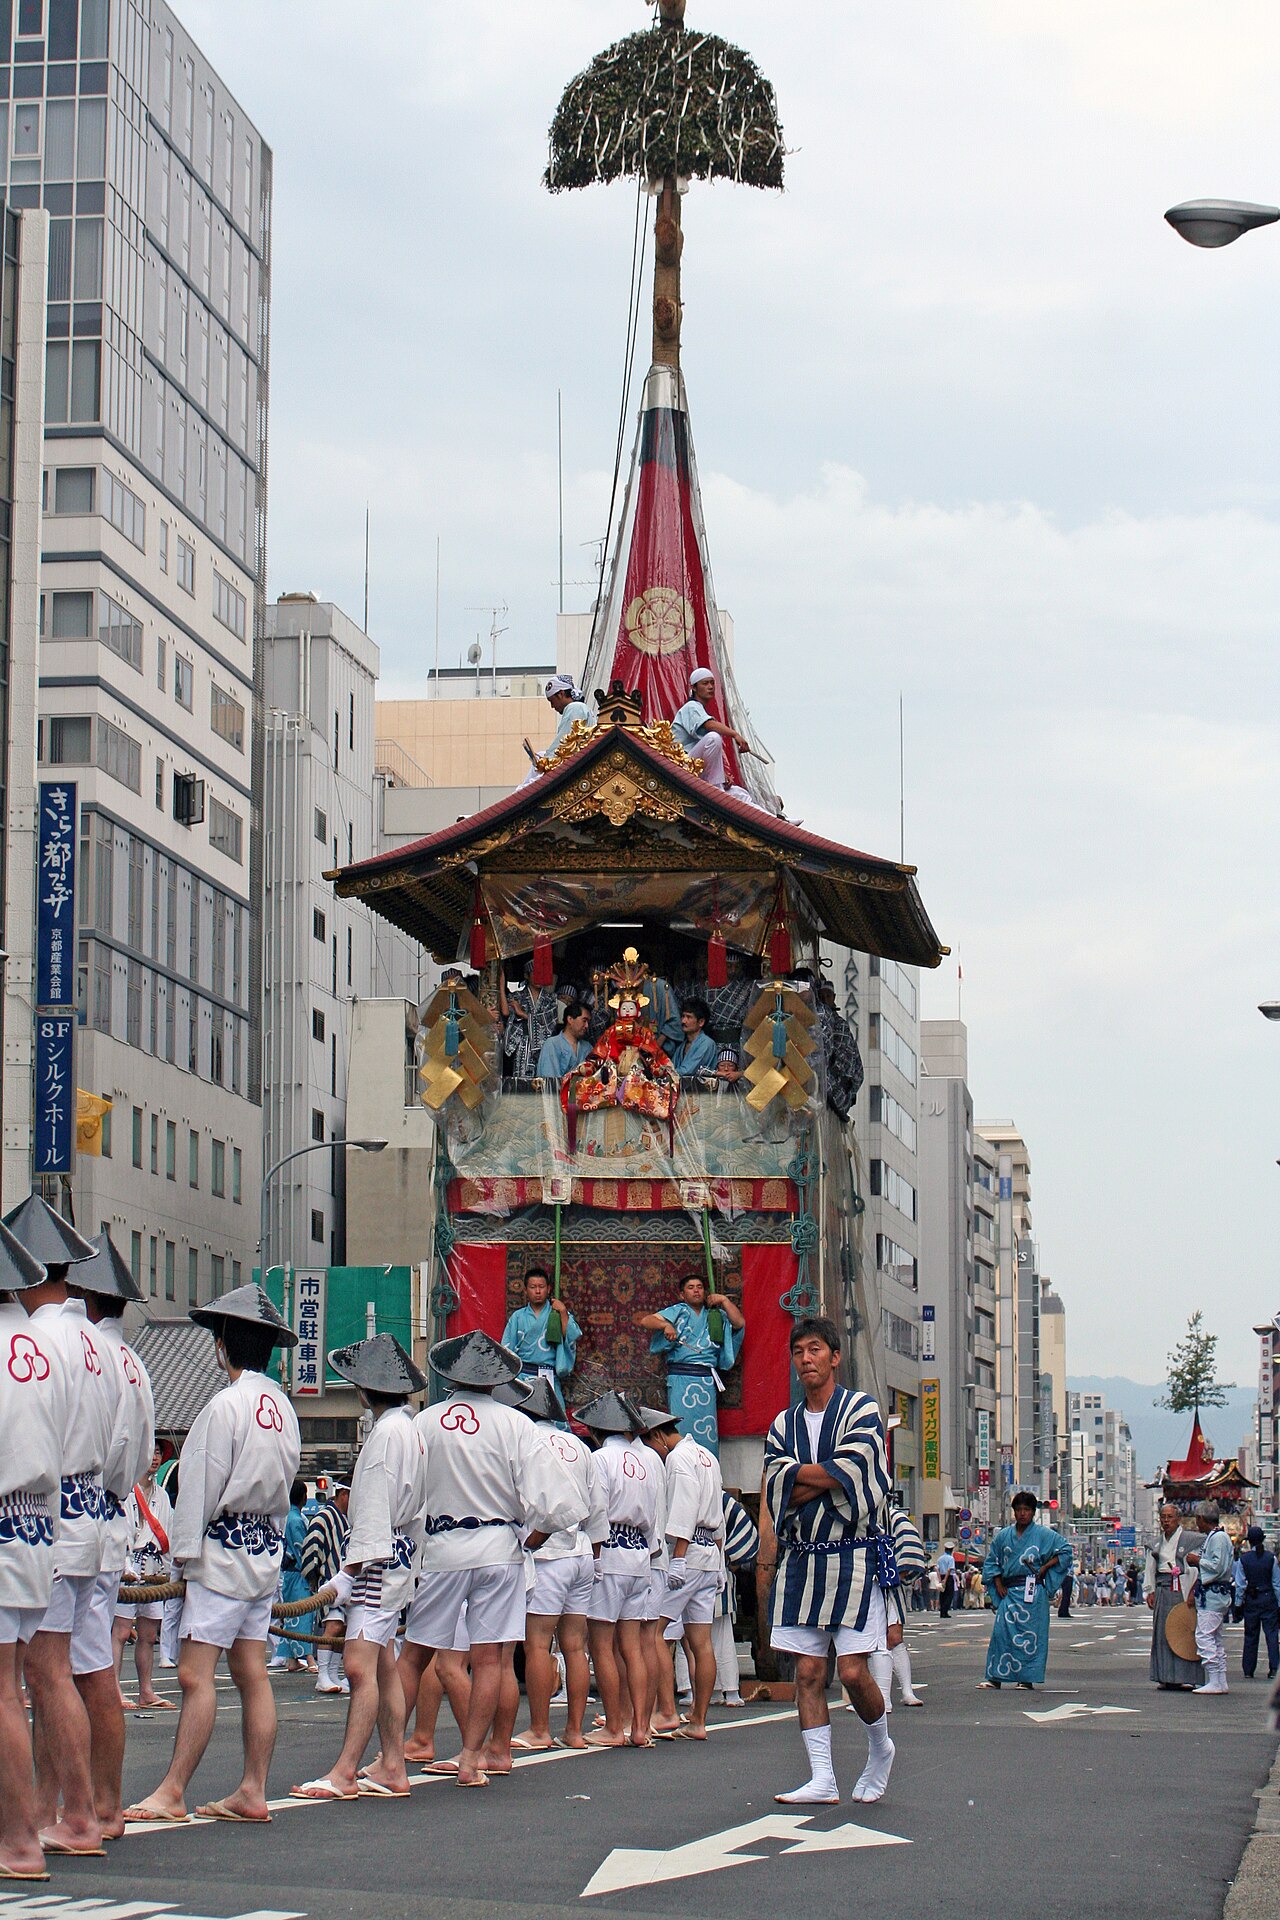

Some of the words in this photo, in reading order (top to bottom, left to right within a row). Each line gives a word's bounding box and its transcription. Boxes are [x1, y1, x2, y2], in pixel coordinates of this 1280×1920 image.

[43, 787, 73, 918] きらっ都プラザ
[50, 928, 62, 999] 京都産業会館
[41, 1022, 70, 1038] 8F
[43, 1042, 66, 1167] シルクホール
[298, 1277, 320, 1384] 市営駐車場
[925, 1397, 938, 1478] ダイガク薬局四条
